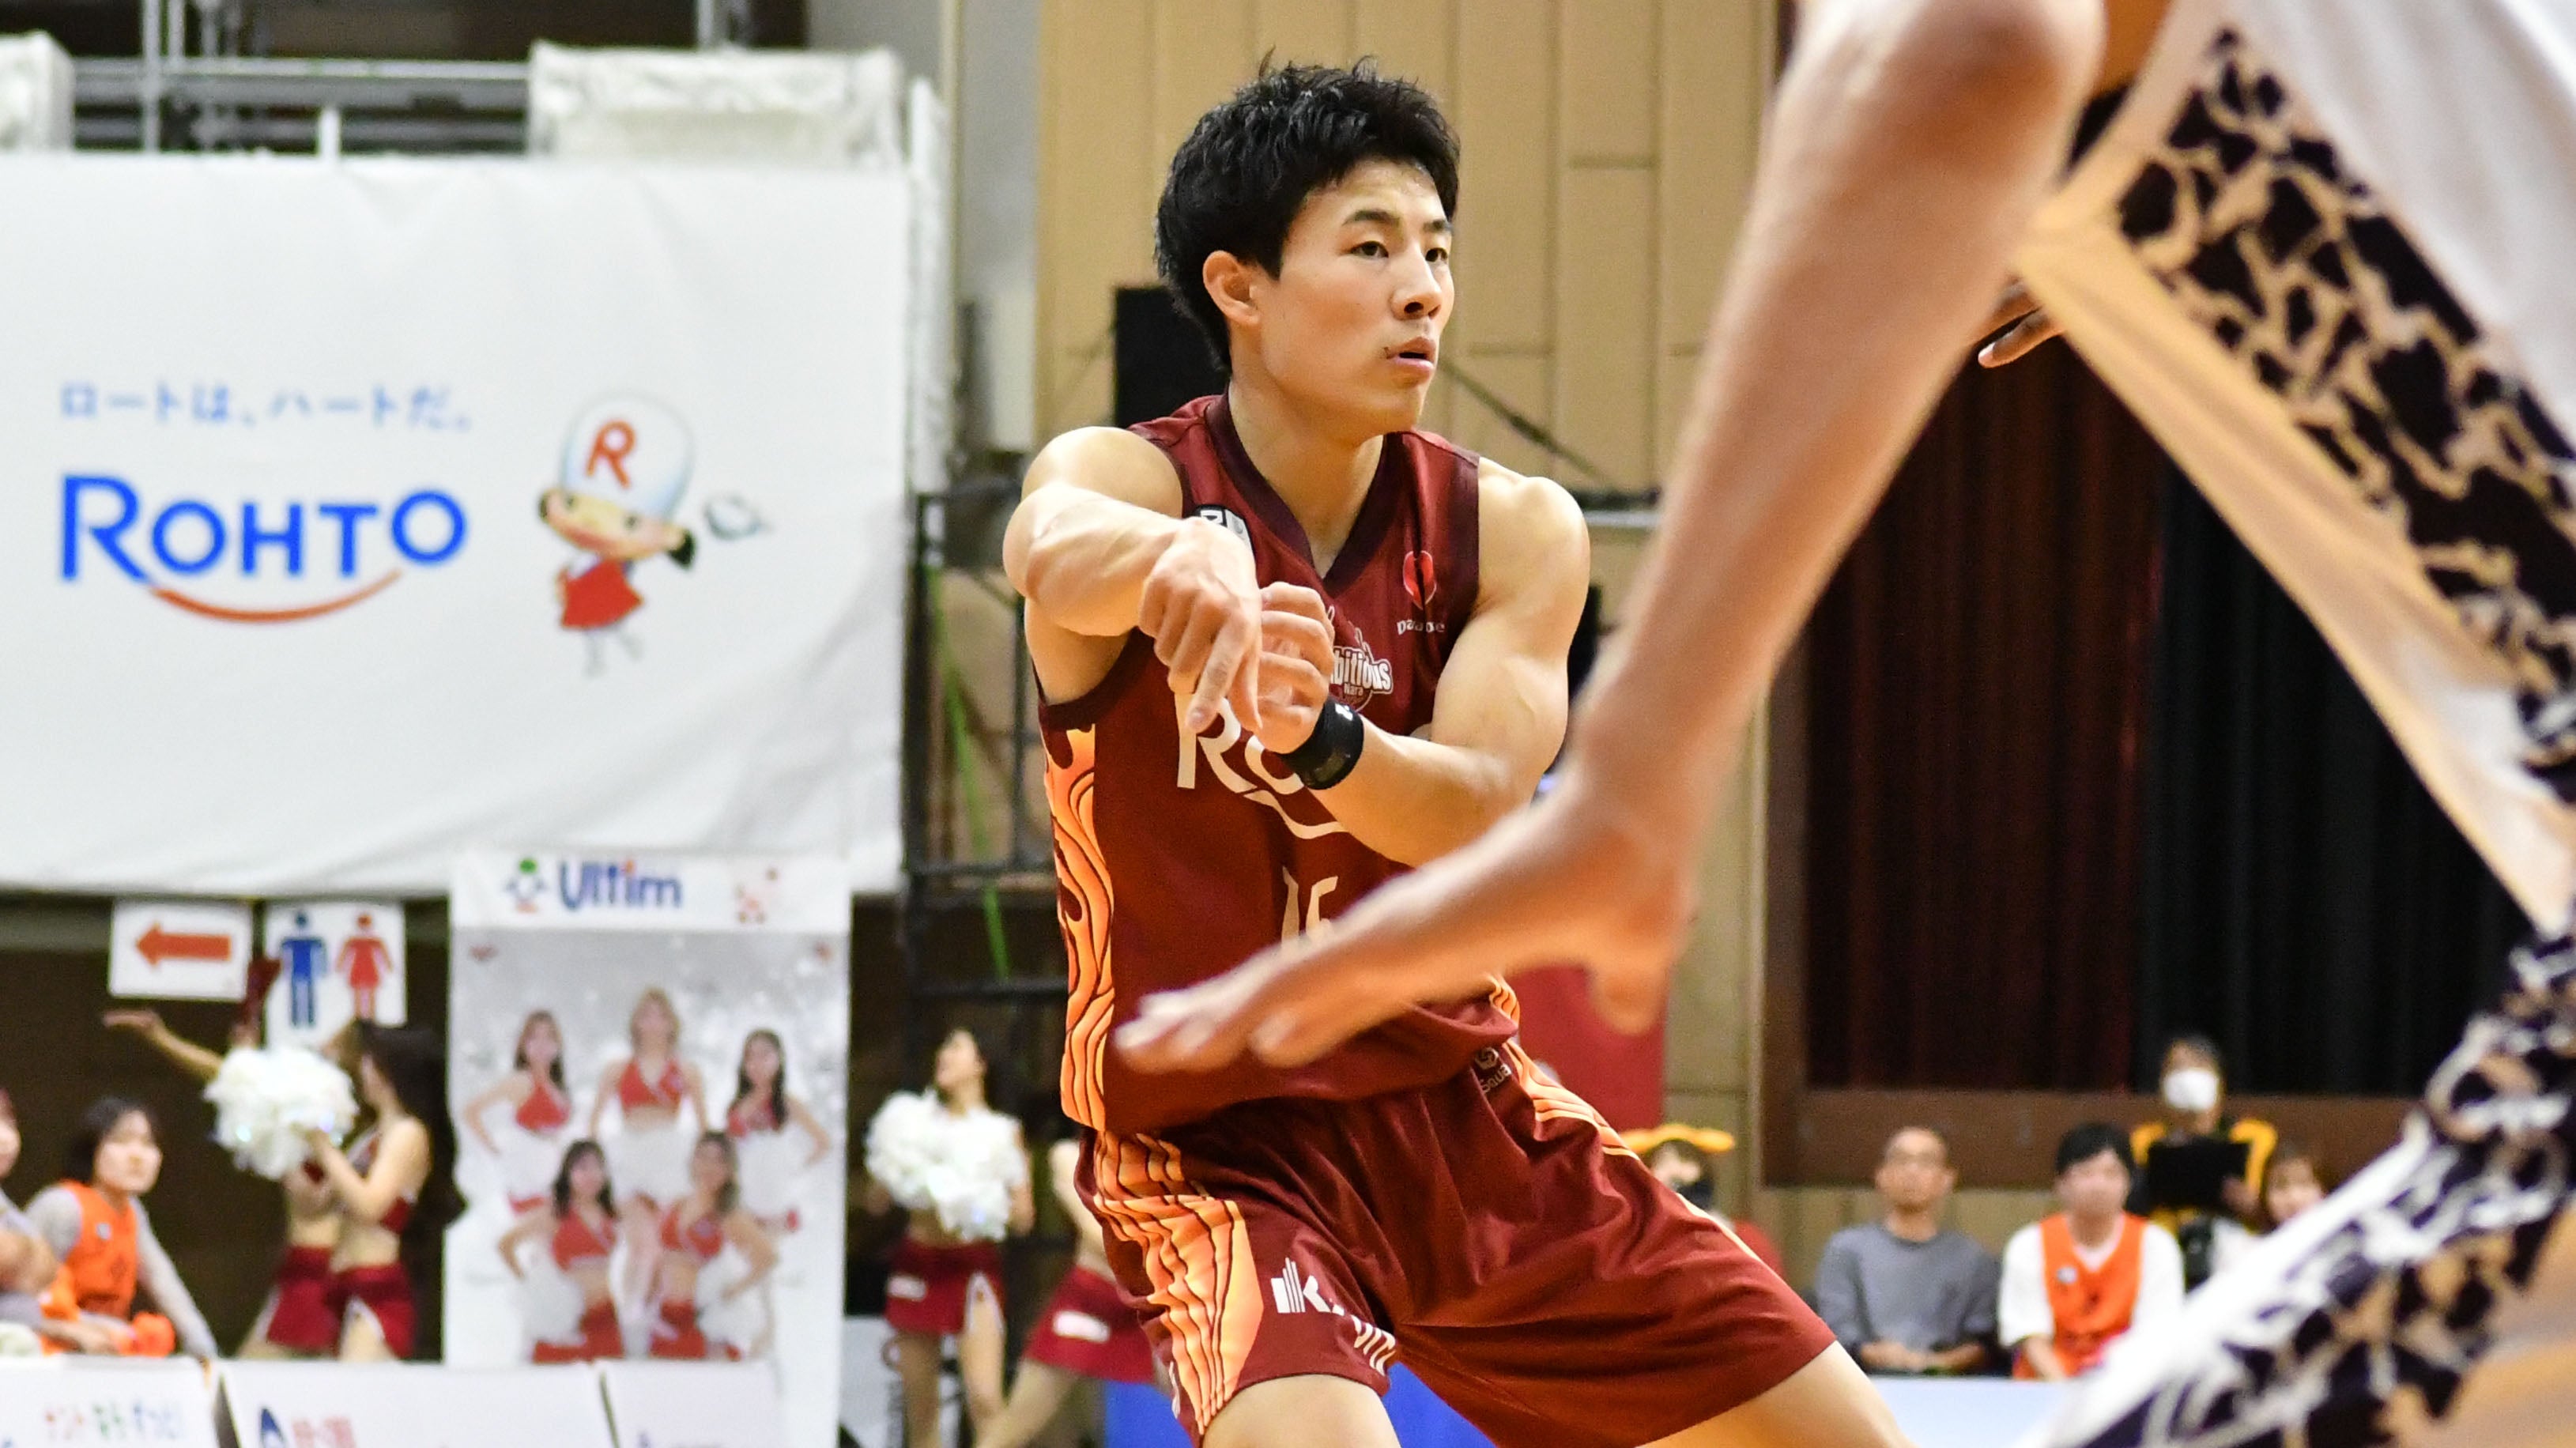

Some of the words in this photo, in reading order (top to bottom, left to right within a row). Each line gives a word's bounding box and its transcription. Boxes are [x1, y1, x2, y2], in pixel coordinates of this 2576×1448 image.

[586, 419, 636, 488] R
[60, 473, 467, 583] ROHTO
[1331, 649, 1391, 692] bitious
[559, 857, 683, 910] Ultim
